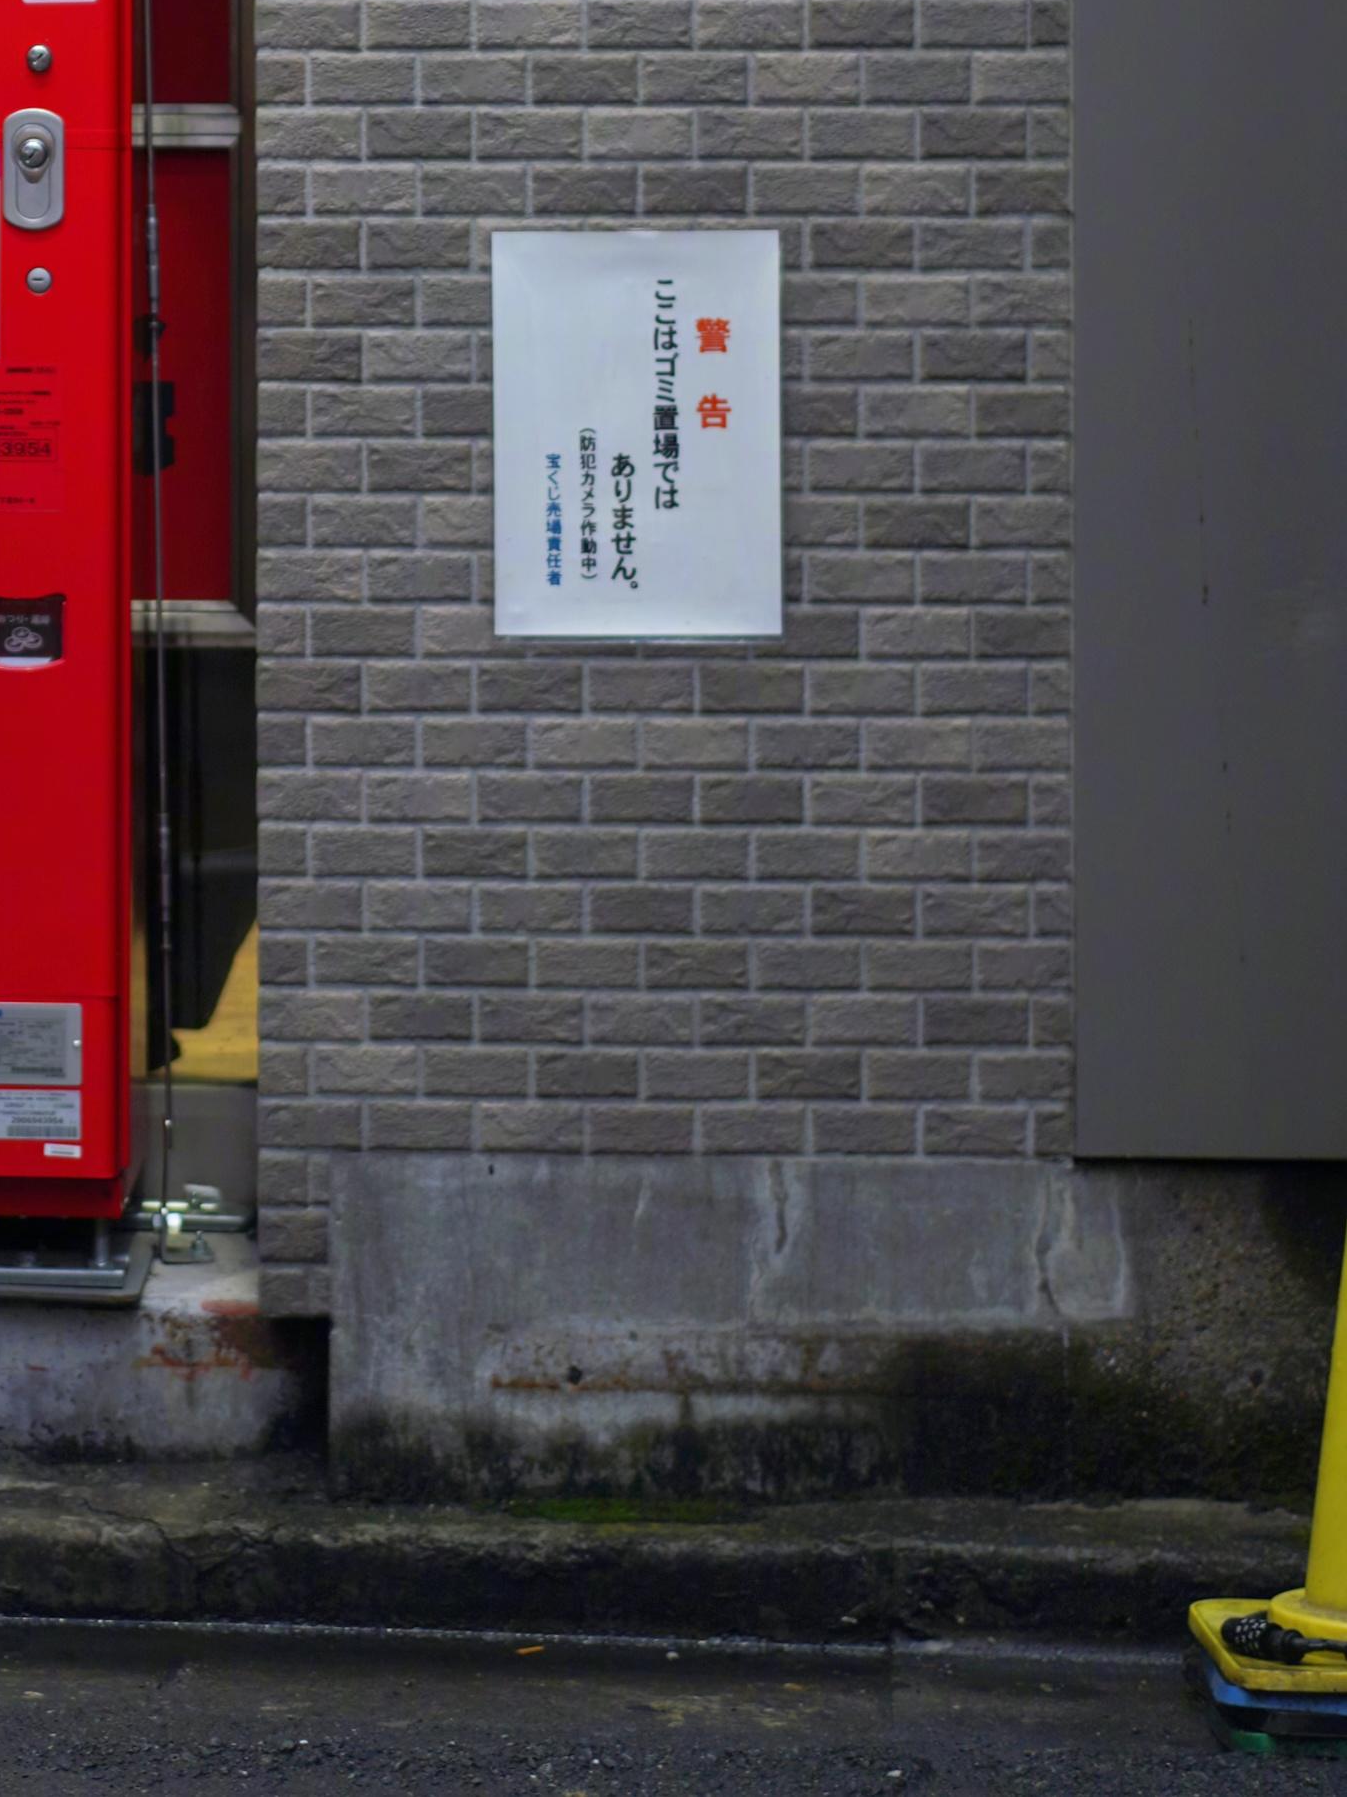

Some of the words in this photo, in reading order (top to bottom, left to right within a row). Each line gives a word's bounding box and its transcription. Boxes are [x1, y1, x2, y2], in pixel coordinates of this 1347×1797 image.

[653, 278, 680, 510] ここはゴミ置場では
[546, 453, 562, 586] 宝くじ売場責任者
[610, 453, 639, 590] ありません。
